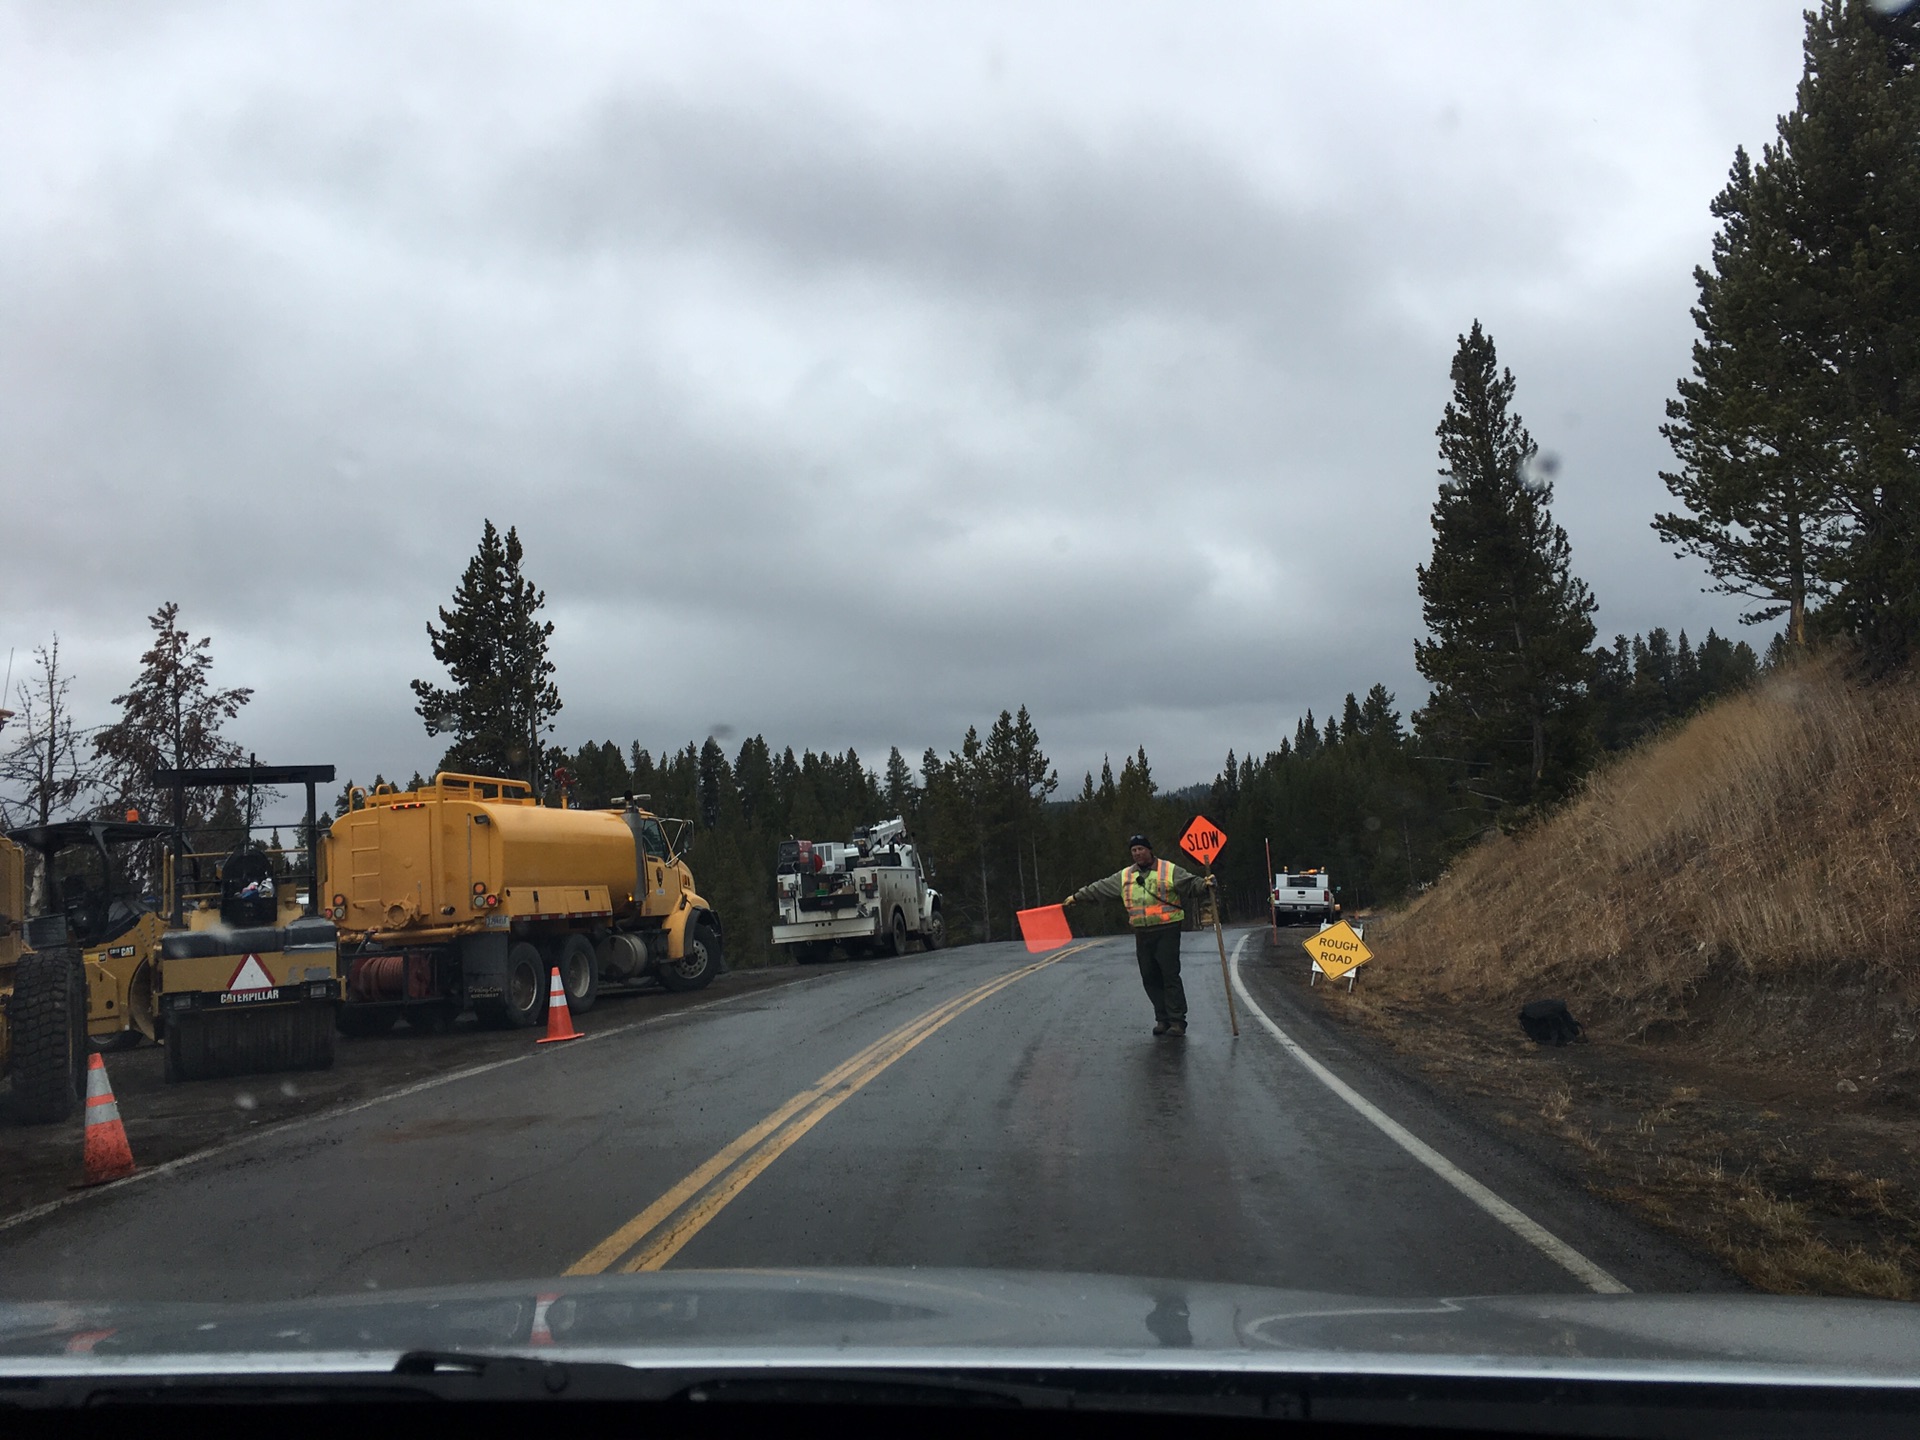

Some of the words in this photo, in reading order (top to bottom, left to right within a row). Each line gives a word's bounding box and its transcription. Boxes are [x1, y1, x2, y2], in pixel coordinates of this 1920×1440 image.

[1187, 830, 1219, 851] SLOW
[121, 946, 134, 957] CAT
[1319, 938, 1358, 952] ROUGH
[1320, 952, 1352, 965] ROAD
[220, 990, 279, 1004] CATERPILLAR
